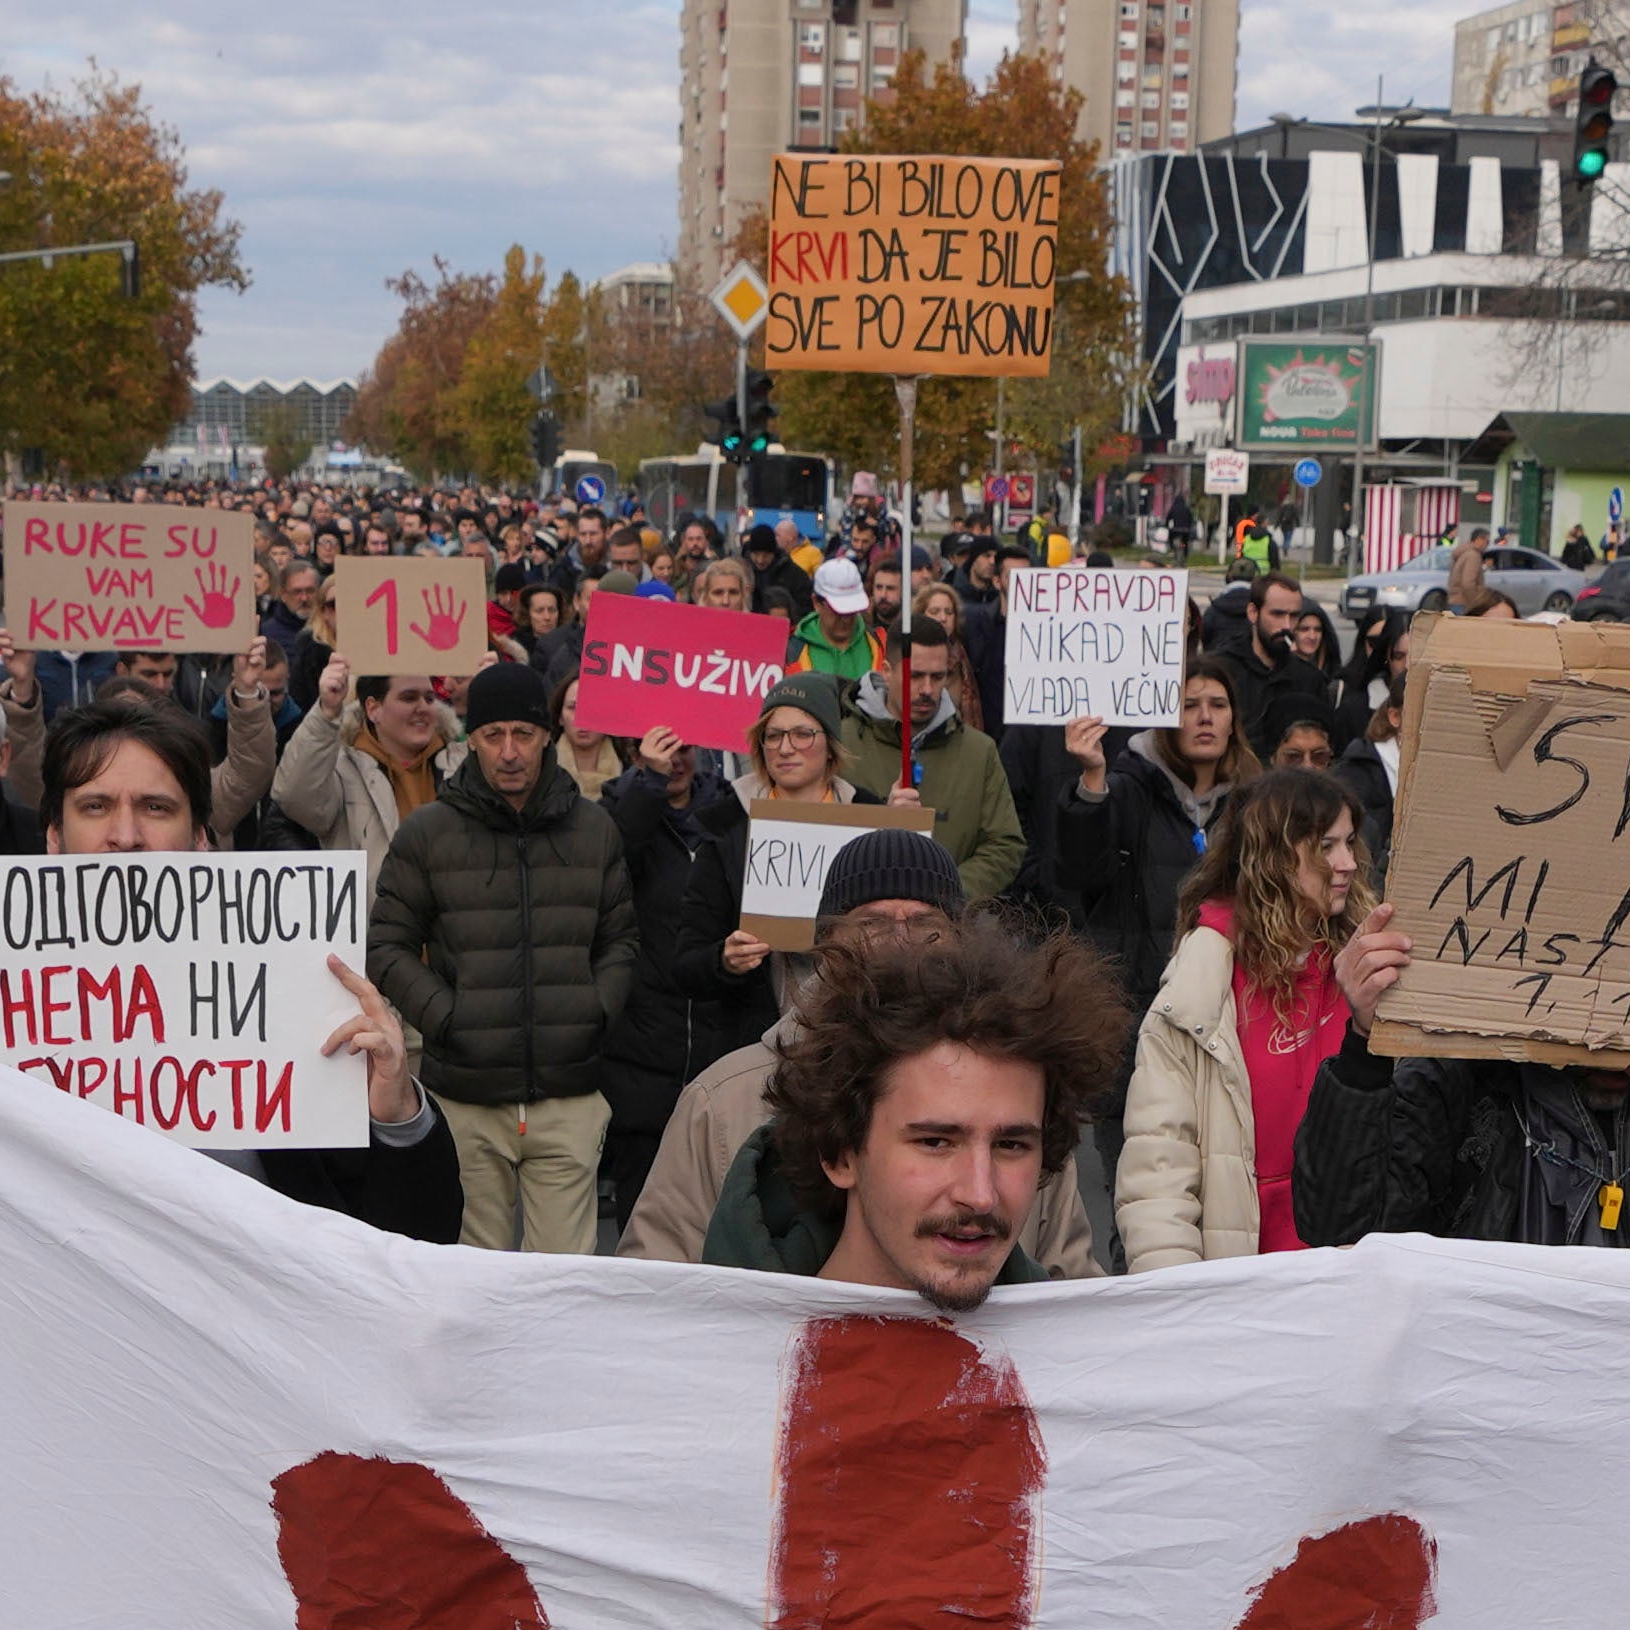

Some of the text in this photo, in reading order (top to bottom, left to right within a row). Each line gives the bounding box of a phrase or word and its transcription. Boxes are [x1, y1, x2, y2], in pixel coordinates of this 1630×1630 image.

[773, 160, 1060, 226] NE BI BILO OVE
[771, 228, 1056, 289] KRVI DA JE BILO
[768, 292, 1052, 356] SVE PO ZAKONU
[25, 518, 217, 559] RUKE SU
[86, 567, 153, 598] VAM
[1014, 572, 1175, 613] NEPRAVDA
[28, 597, 185, 643] KRVAVE
[1142, 621, 1180, 666] NE
[1008, 672, 1181, 717] VLADA VEČNO
[746, 839, 826, 890] KRIVI
[3, 863, 357, 952] ОДГОВОРНОСТИ
[1428, 855, 1550, 926] MI
[0, 961, 266, 1048] НЕМА НИ
